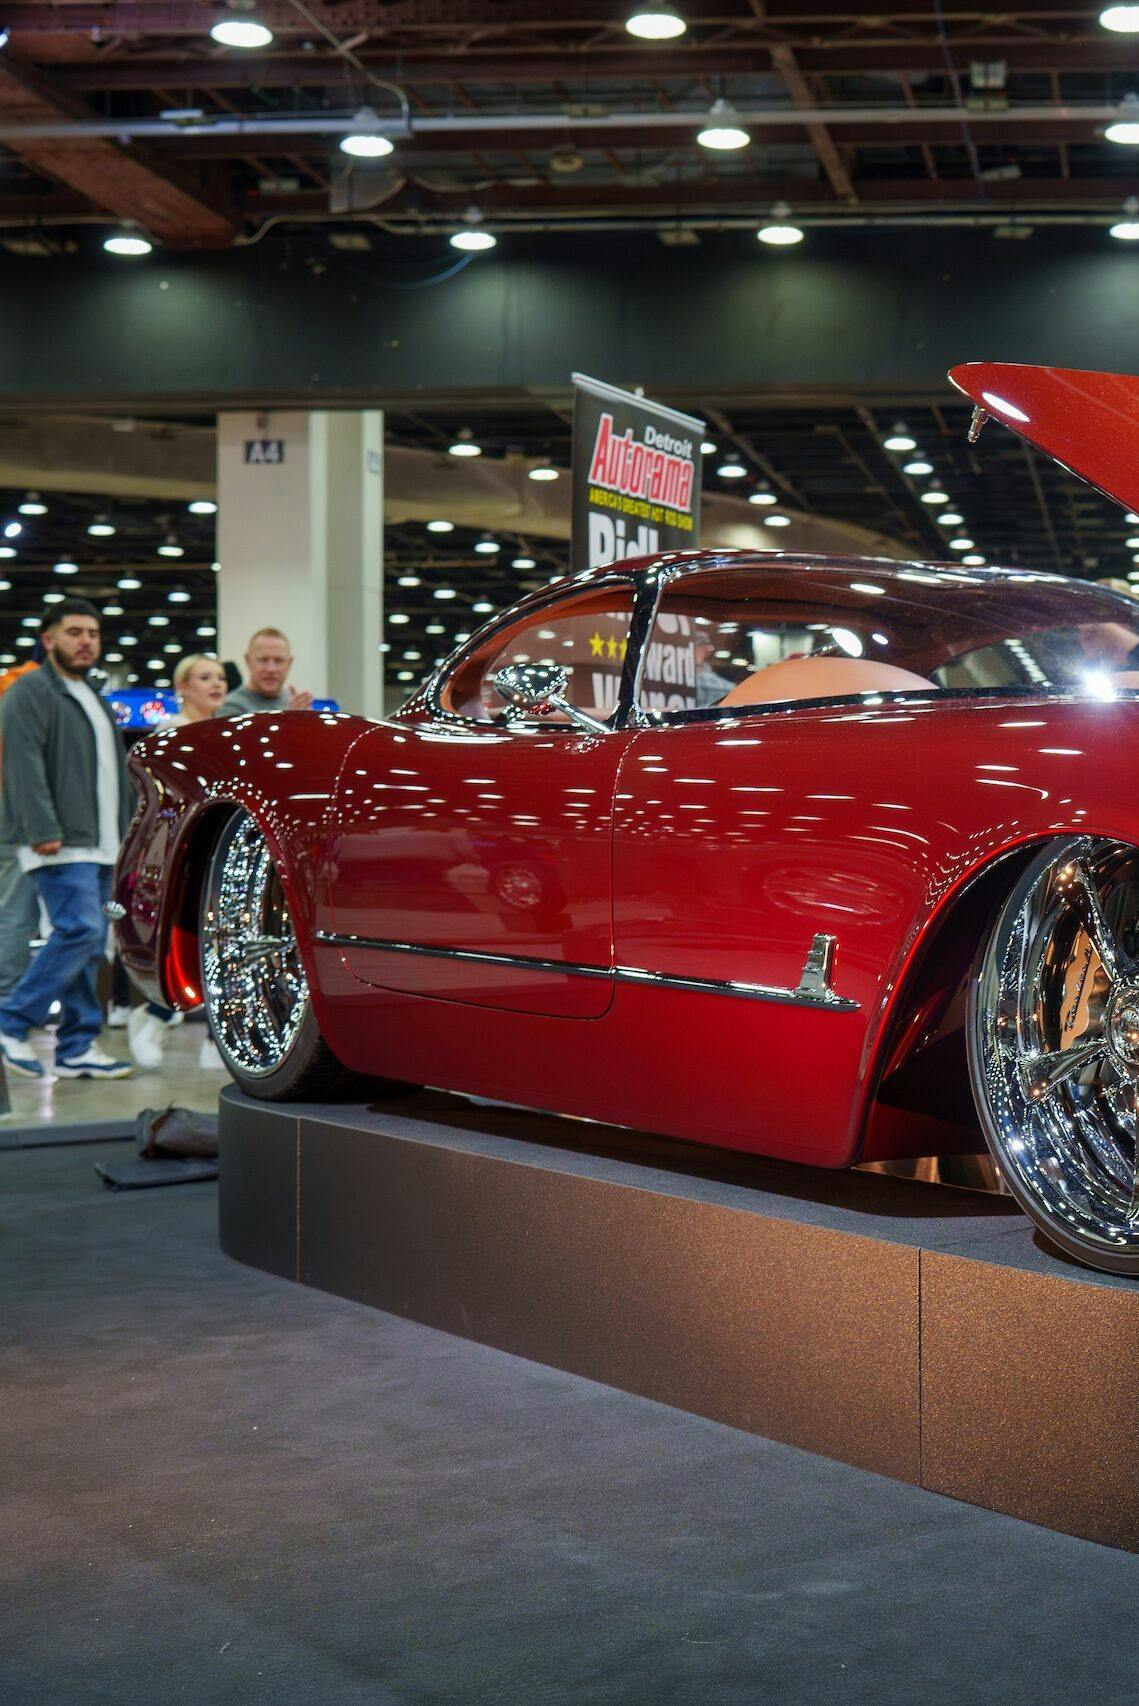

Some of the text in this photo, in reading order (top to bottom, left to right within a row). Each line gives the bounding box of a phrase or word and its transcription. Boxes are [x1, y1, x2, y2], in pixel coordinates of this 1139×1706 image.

[248, 441, 281, 463] A4
[644, 425, 692, 458] Detroit
[588, 413, 694, 512] Autorama
[643, 641, 695, 688] ward
